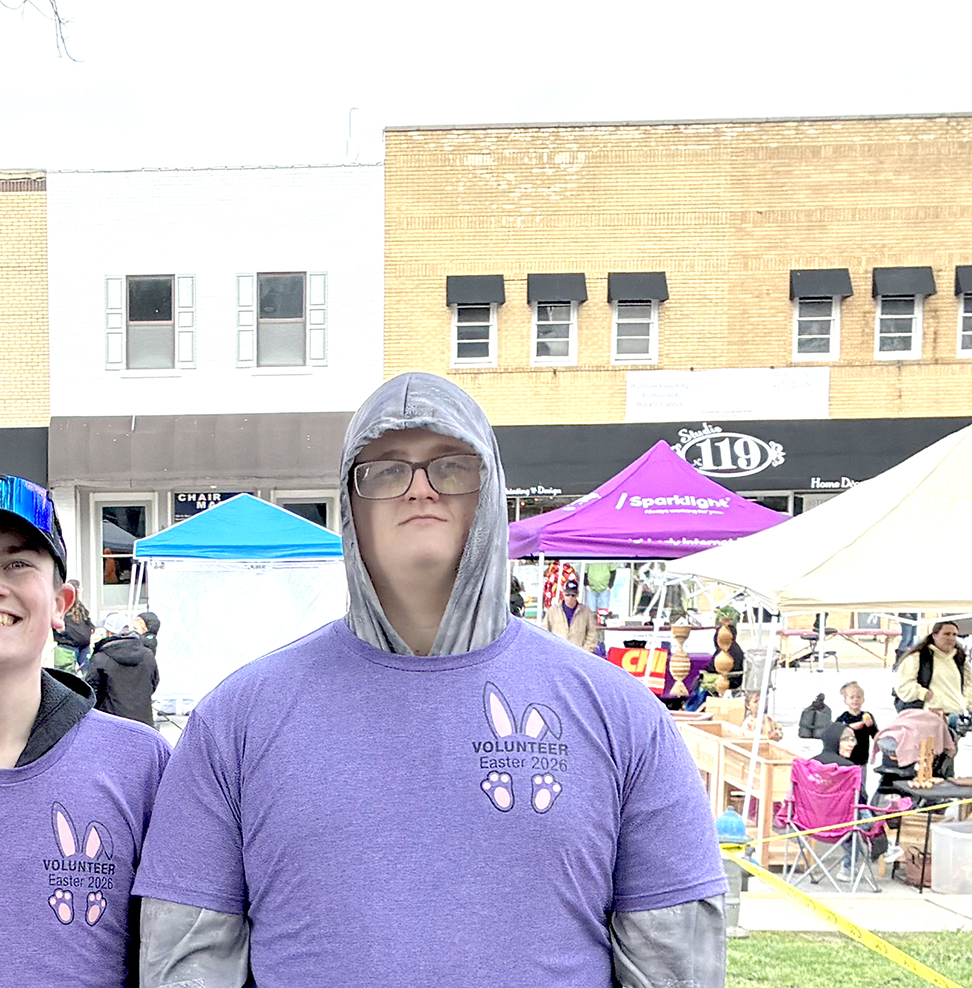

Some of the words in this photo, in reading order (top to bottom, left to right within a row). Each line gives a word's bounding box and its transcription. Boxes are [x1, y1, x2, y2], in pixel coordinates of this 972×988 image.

[678, 422, 722, 443] Studio
[696, 437, 761, 470] 119
[810, 477, 840, 488] Home
[177, 493, 221, 502] CHAIR
[196, 500, 220, 510] MA
[629, 495, 730, 509] Sparklight
[472, 741, 569, 756] VOLUNTEER
[479, 756, 526, 769] Easter
[531, 756, 568, 772] 2026
[43, 859, 116, 875] VOLUNTEER
[48, 874, 84, 888] Easter
[88, 876, 114, 890] 2026
